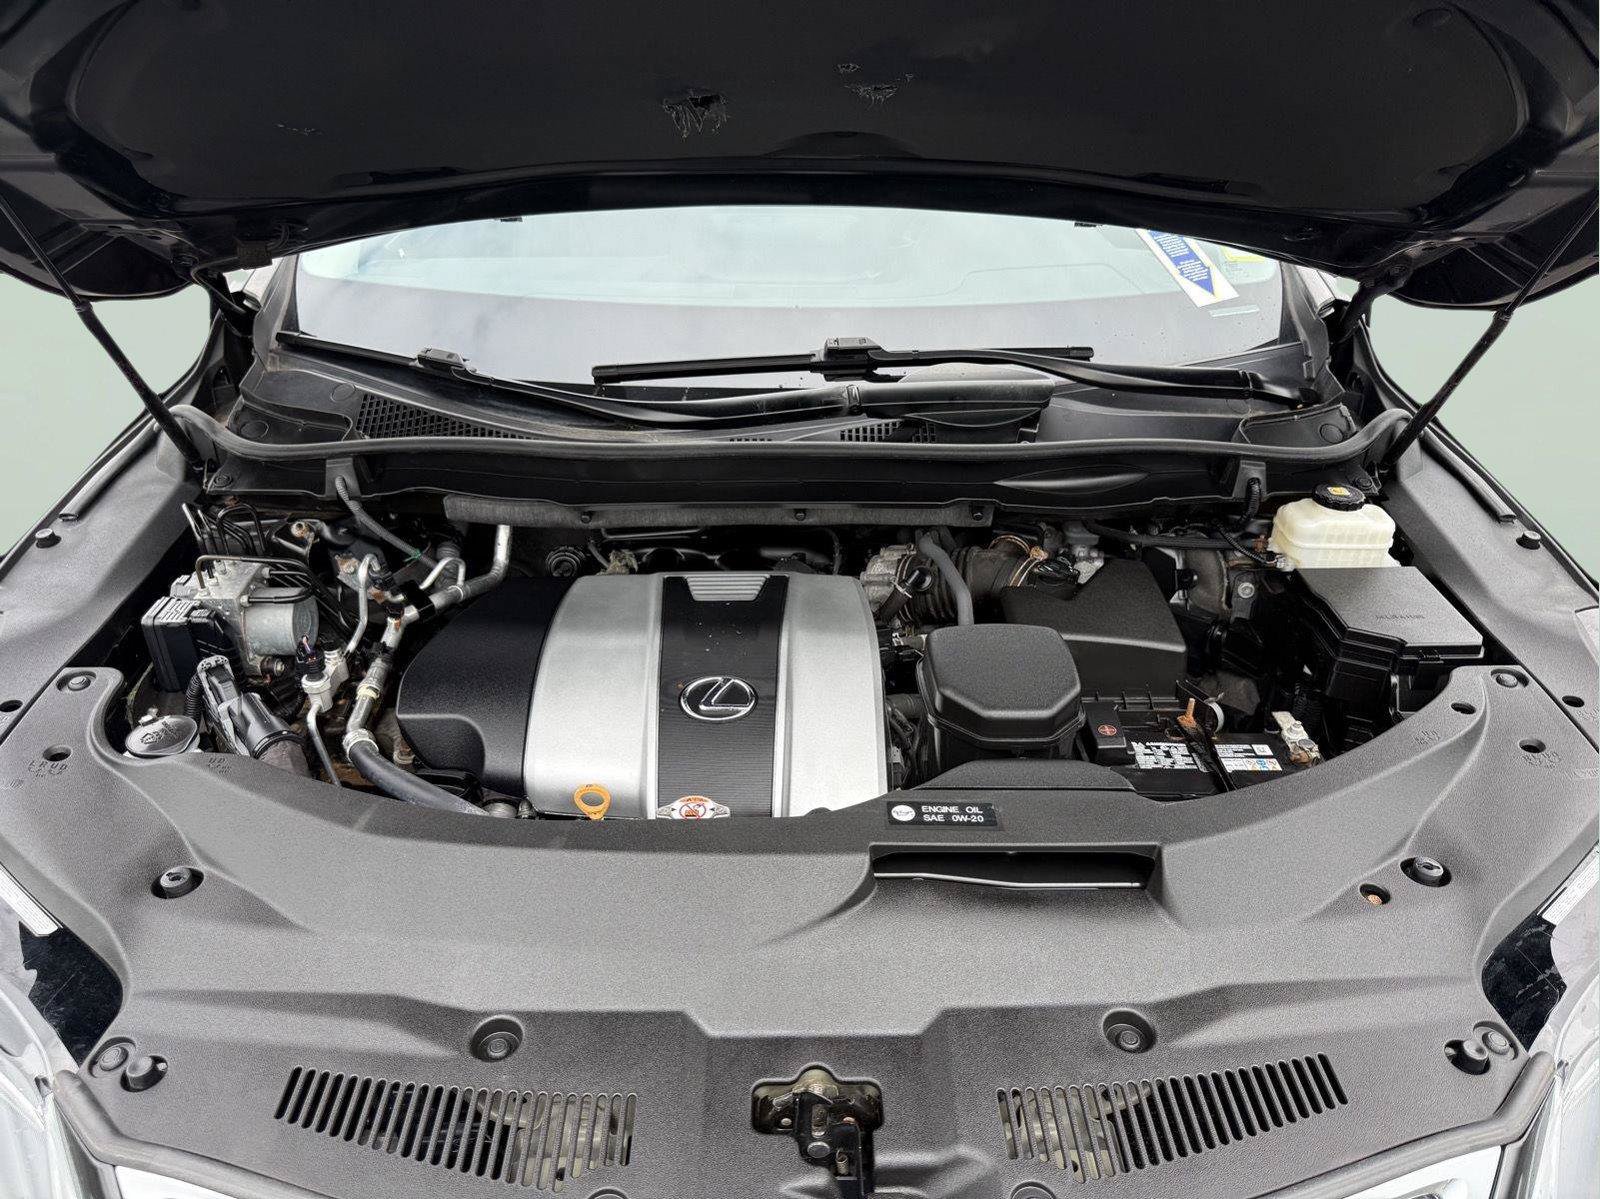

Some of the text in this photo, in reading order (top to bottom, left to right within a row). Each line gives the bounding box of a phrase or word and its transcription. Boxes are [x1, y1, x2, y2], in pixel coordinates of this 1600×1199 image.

[921, 805, 959, 813] ENGINE
[965, 806, 983, 814] OIL
[923, 814, 984, 823] SAE 0W-20
